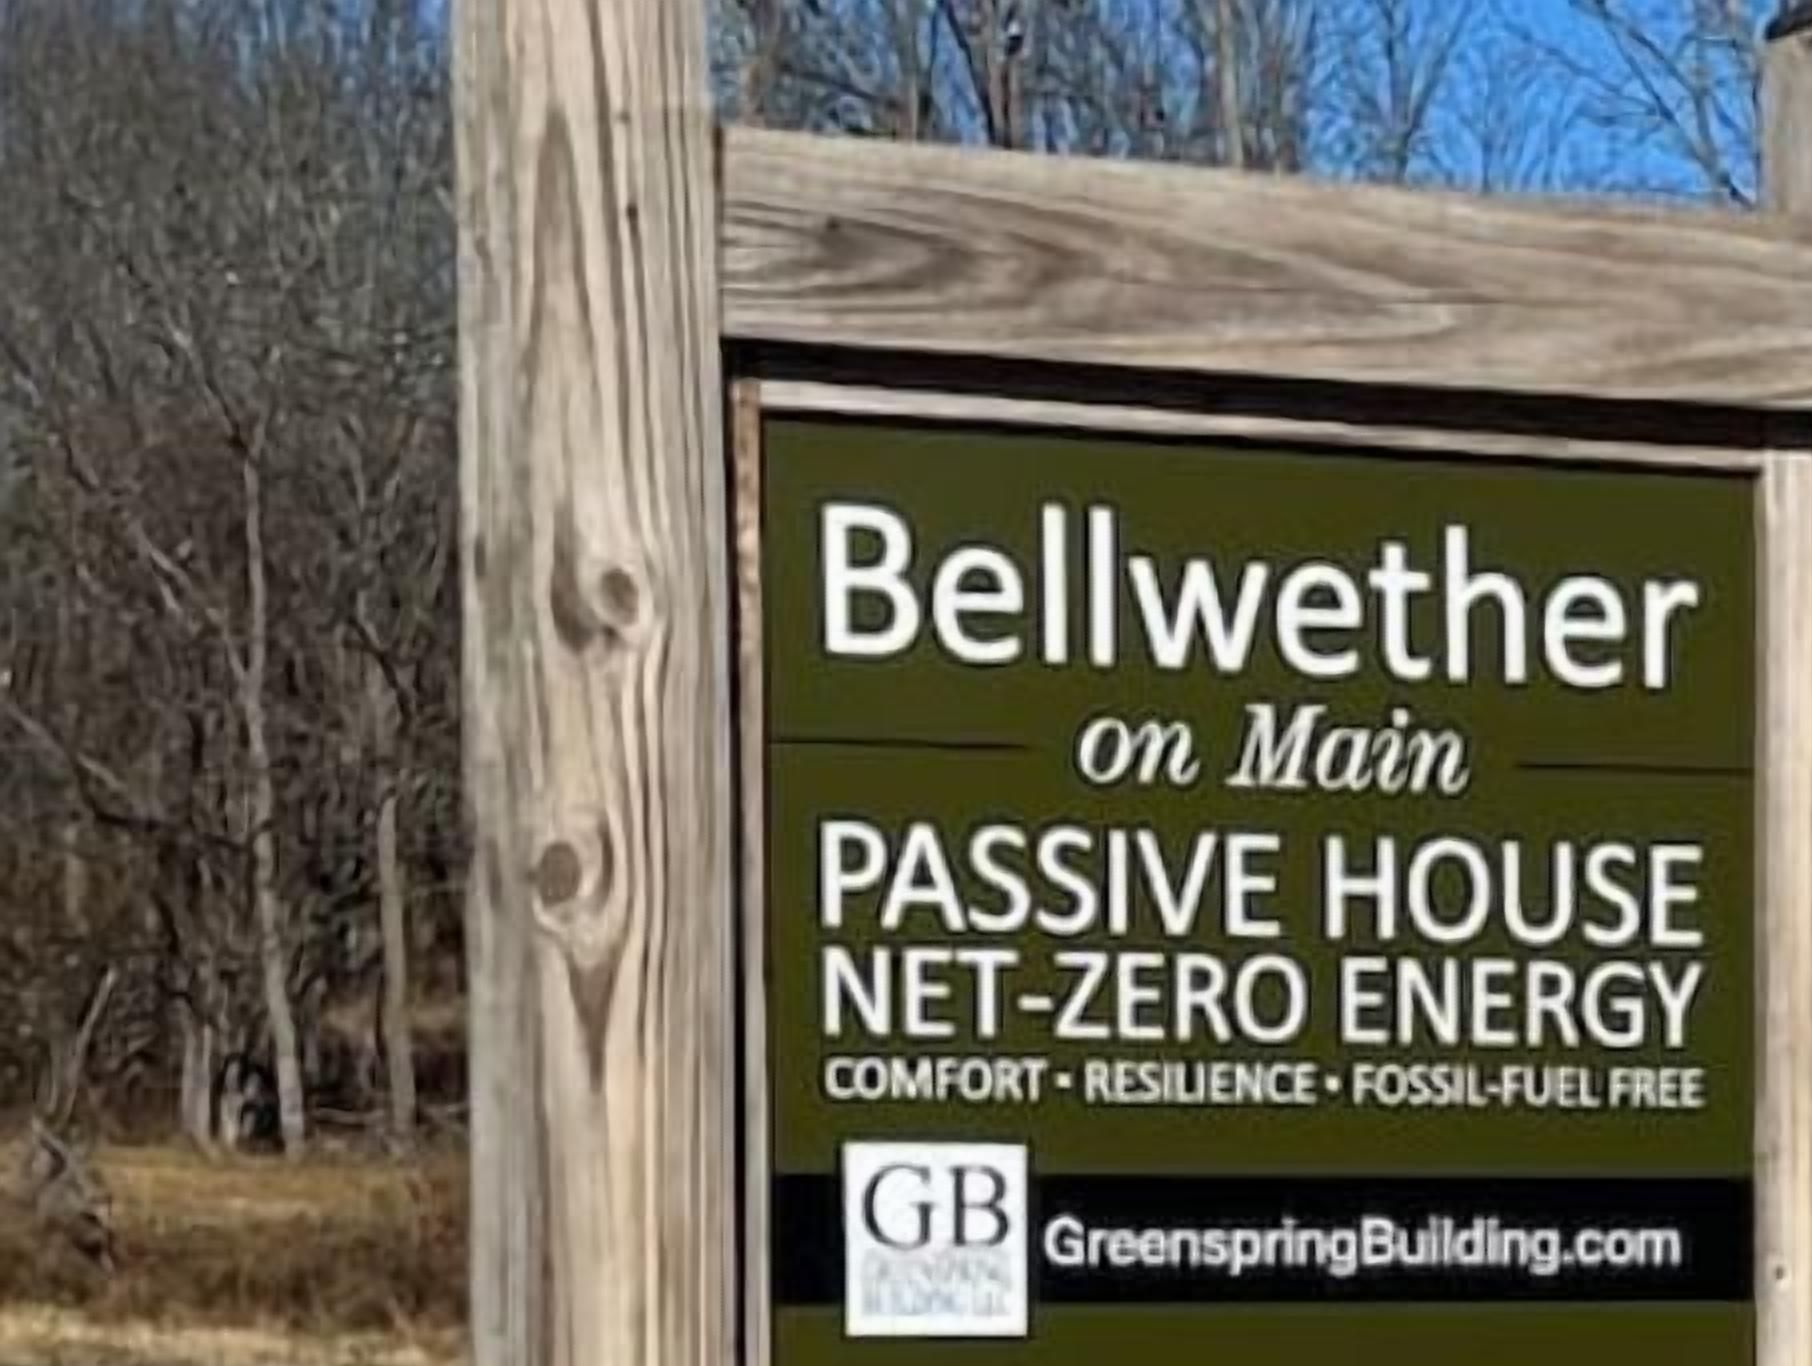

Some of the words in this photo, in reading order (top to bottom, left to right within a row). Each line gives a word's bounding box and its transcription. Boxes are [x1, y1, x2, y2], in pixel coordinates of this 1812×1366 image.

[820, 501, 1699, 688] Bellwether
[1078, 716, 1198, 788] on
[1228, 703, 1469, 793] Main
[820, 820, 1280, 938] PASSIVE
[1326, 834, 1703, 946] HOUSE
[821, 950, 1306, 1044] NET-ZERO
[1342, 958, 1704, 1048] ENERGY
[825, 1059, 1046, 1102] COMFORT
[1084, 1062, 1315, 1104] RESILIENCE
[1352, 1065, 1601, 1106] FOSSIL-FUEL
[1609, 1069, 1703, 1108] FREE
[862, 1162, 1010, 1250] GB
[1044, 1214, 1681, 1276] GreenspringBuilding.com
